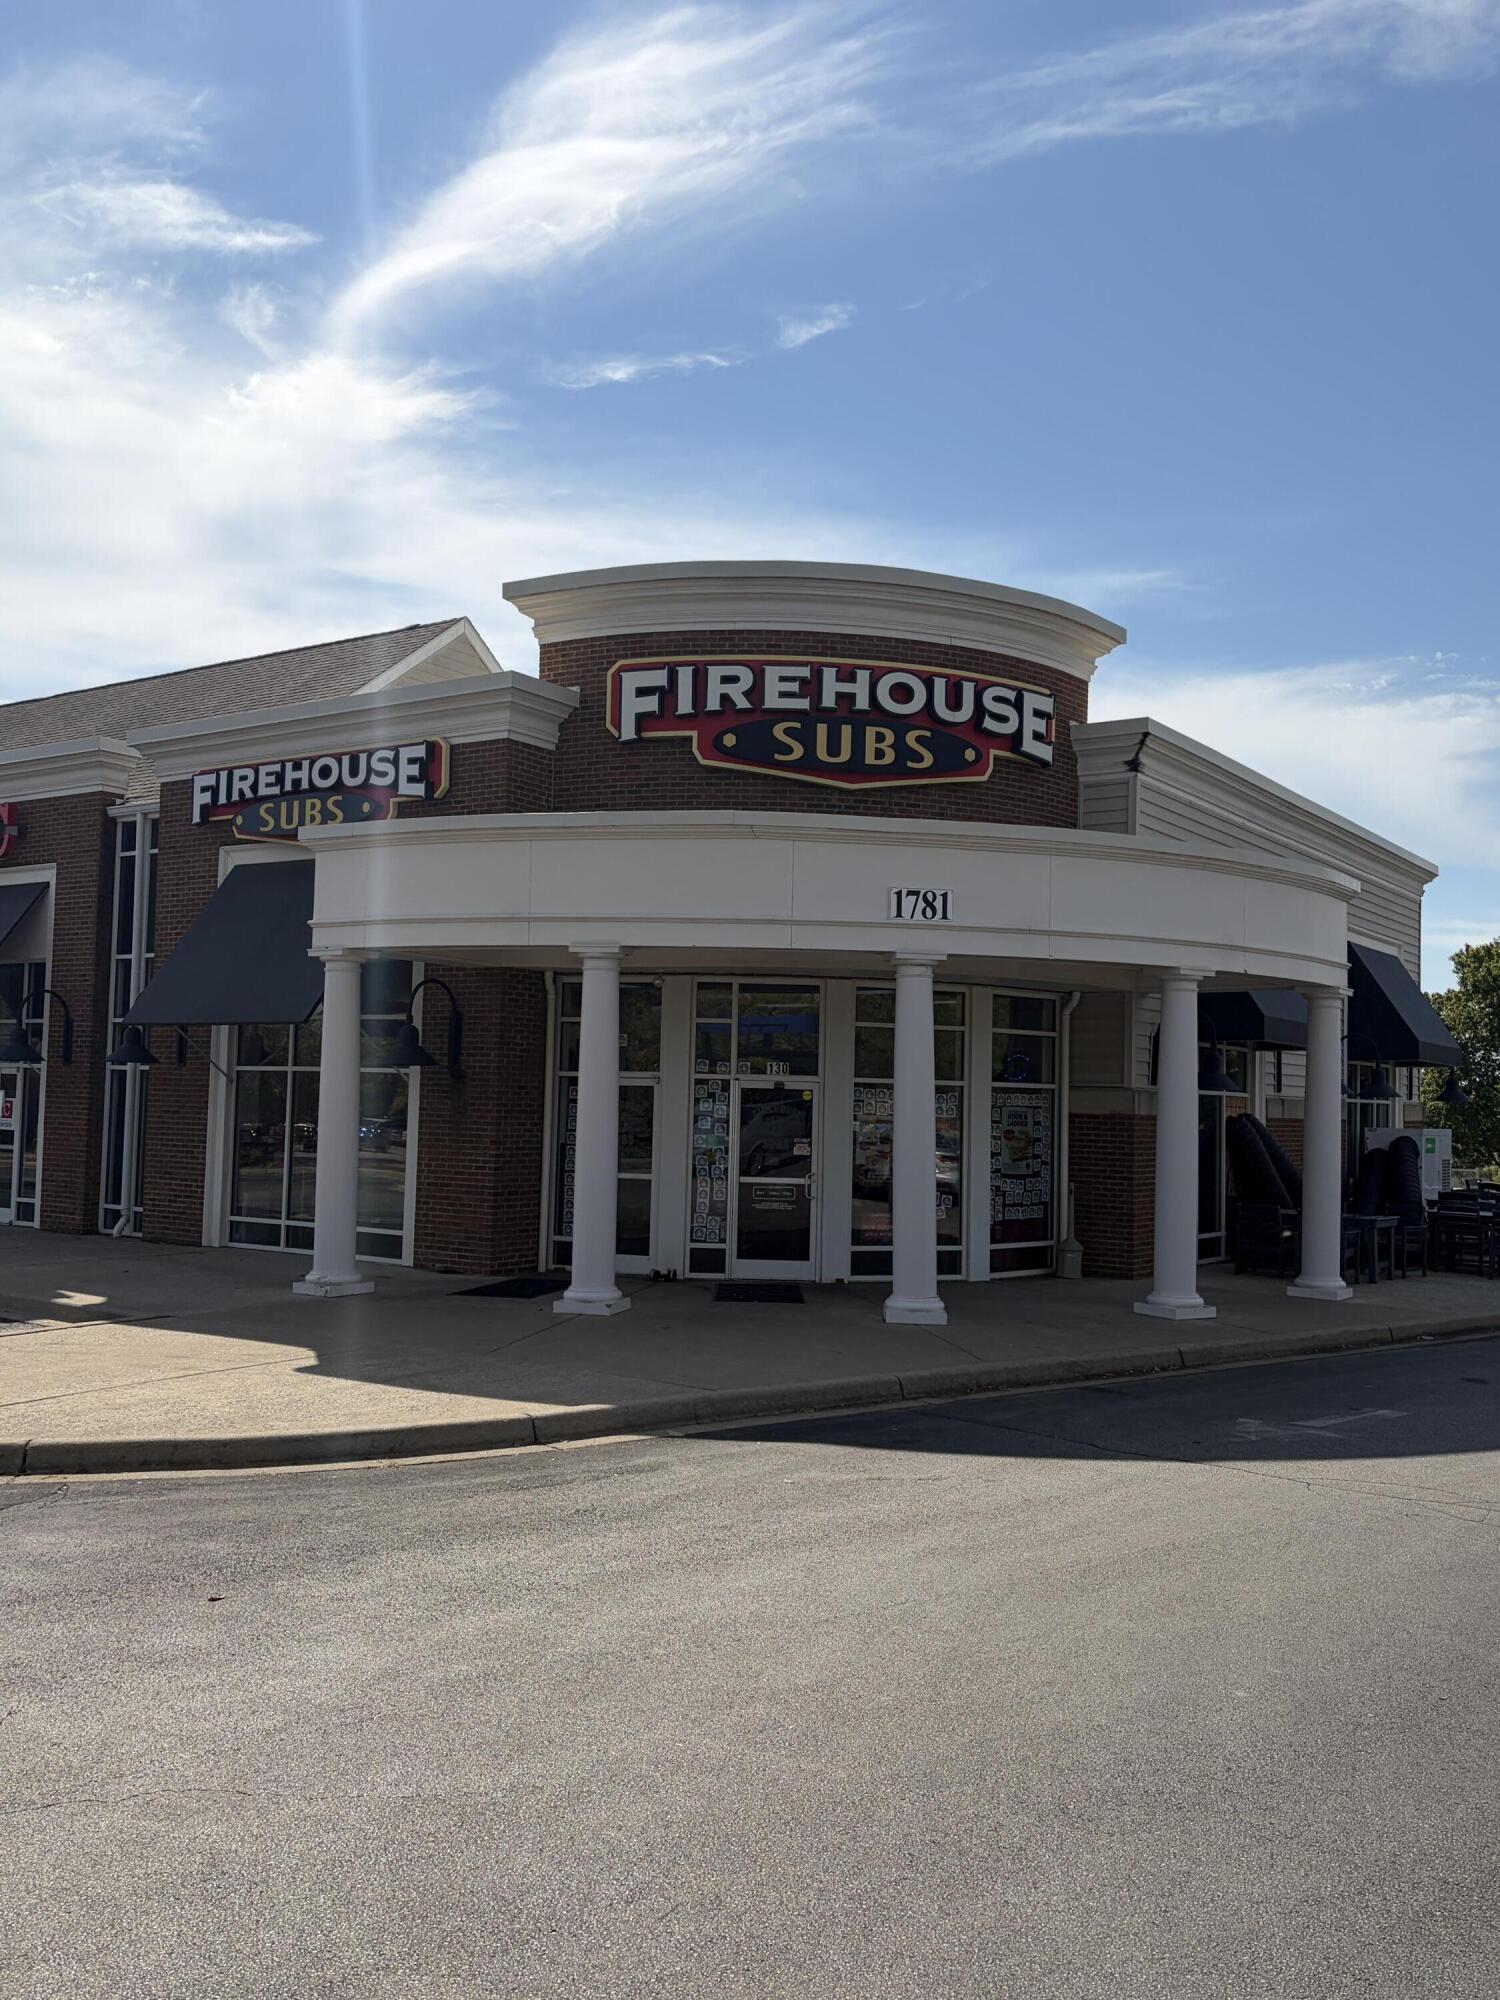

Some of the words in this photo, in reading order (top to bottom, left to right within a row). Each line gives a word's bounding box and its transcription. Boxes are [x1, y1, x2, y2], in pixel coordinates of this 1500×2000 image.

[615, 664, 1055, 767] FIREHOUSE
[773, 720, 935, 770] SUBS
[190, 742, 428, 826] FIREHOUSE
[258, 795, 344, 832] SUBS
[892, 889, 951, 921] 1781
[768, 1062, 789, 1074] 130
